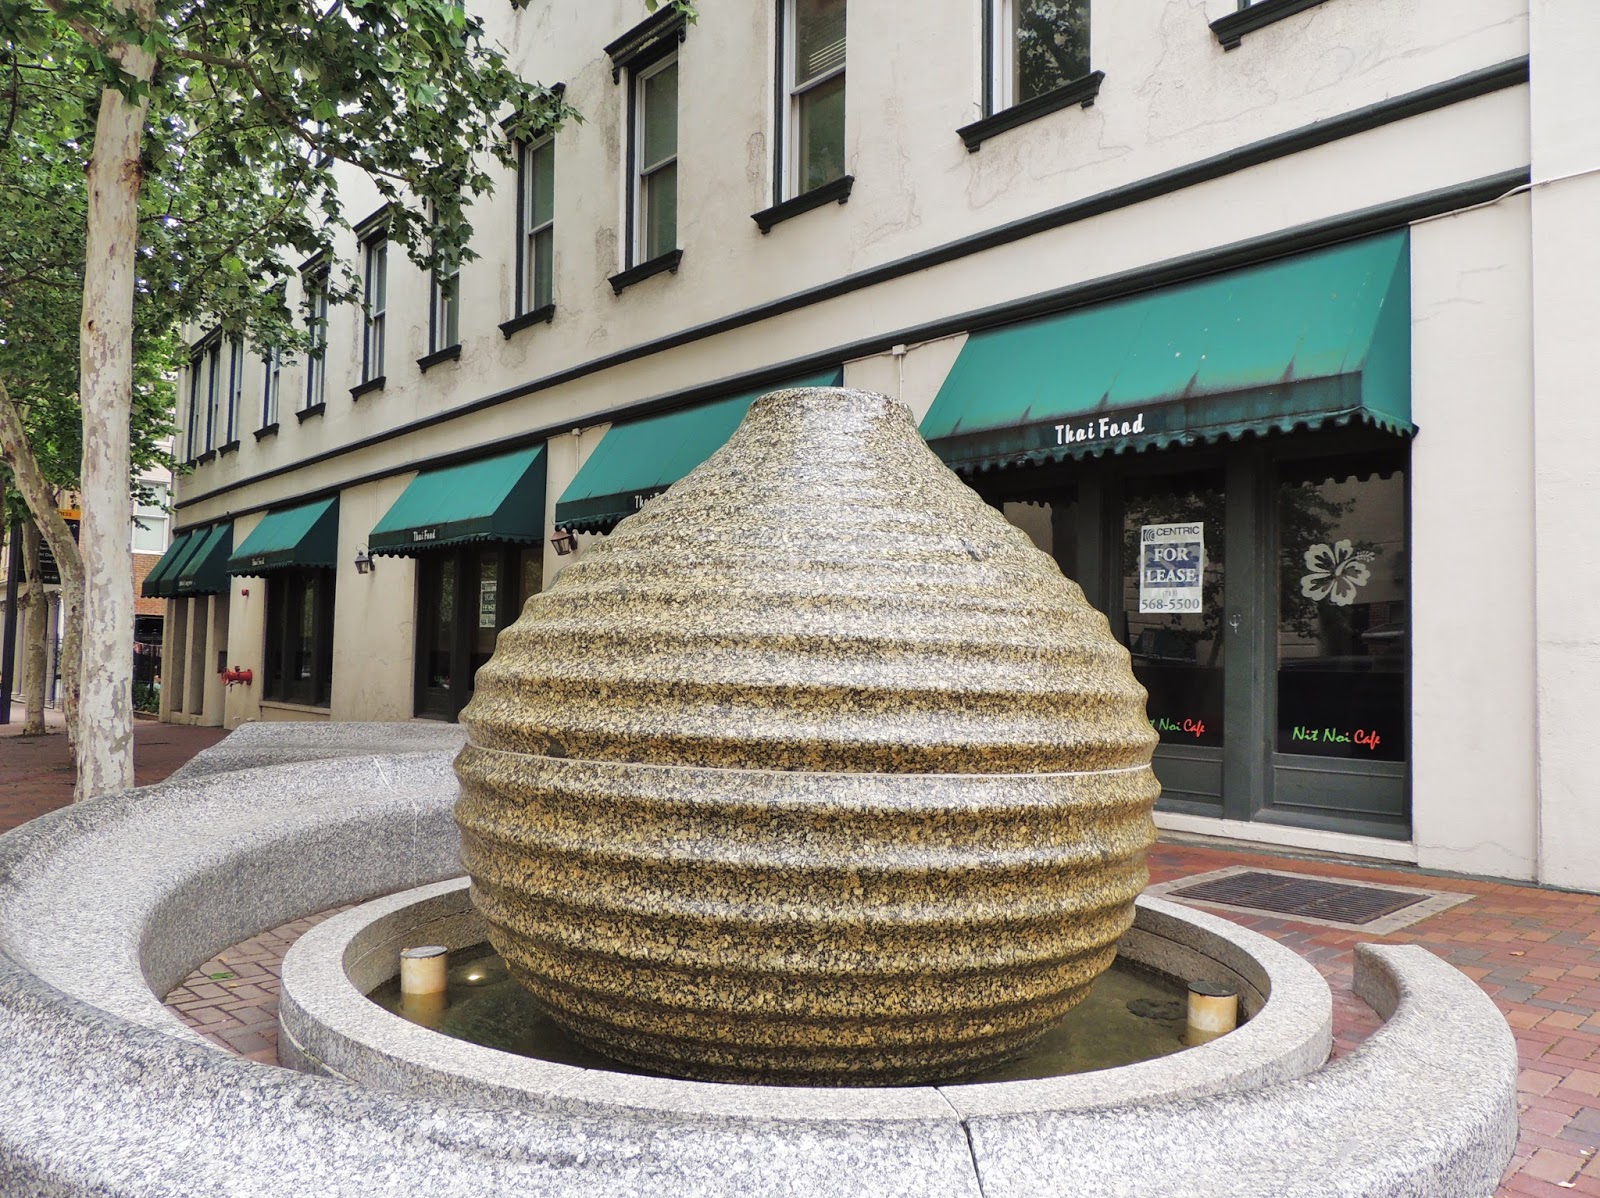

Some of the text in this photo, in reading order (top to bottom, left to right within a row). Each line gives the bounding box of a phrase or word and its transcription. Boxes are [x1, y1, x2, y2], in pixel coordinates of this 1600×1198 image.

[1055, 413, 1145, 444] Thai Food
[1156, 526, 1200, 537] CENTRIC
[1153, 547, 1189, 562] FOR
[1146, 568, 1197, 583] LEASE
[1141, 599, 1200, 610] 568-5500
[1159, 718, 1181, 731] Noi
[1183, 719, 1205, 737] Cafe
[1292, 726, 1380, 750] Nit Noi Cafe
